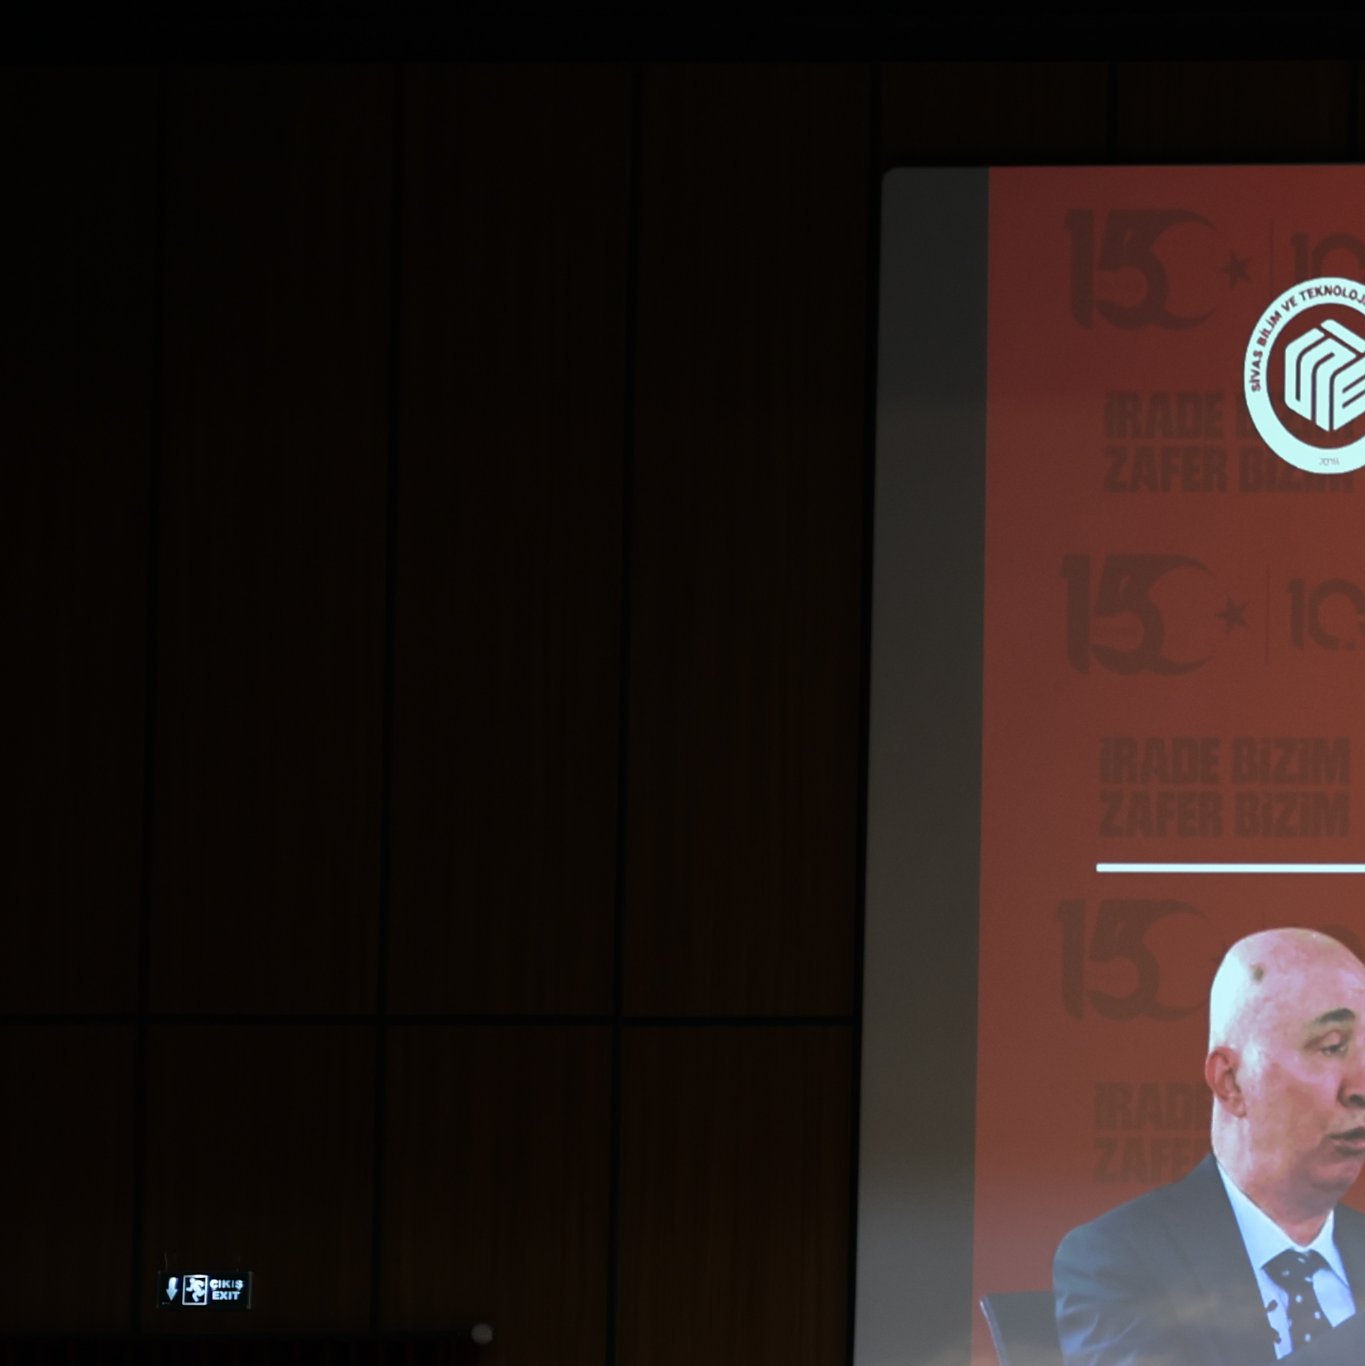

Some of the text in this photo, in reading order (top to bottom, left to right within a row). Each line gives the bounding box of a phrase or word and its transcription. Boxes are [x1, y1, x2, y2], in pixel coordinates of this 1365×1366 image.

[1281, 296, 1298, 312] VE
[209, 1279, 244, 1291] ÇIKIŞ
[212, 1291, 241, 1301] EXIT
